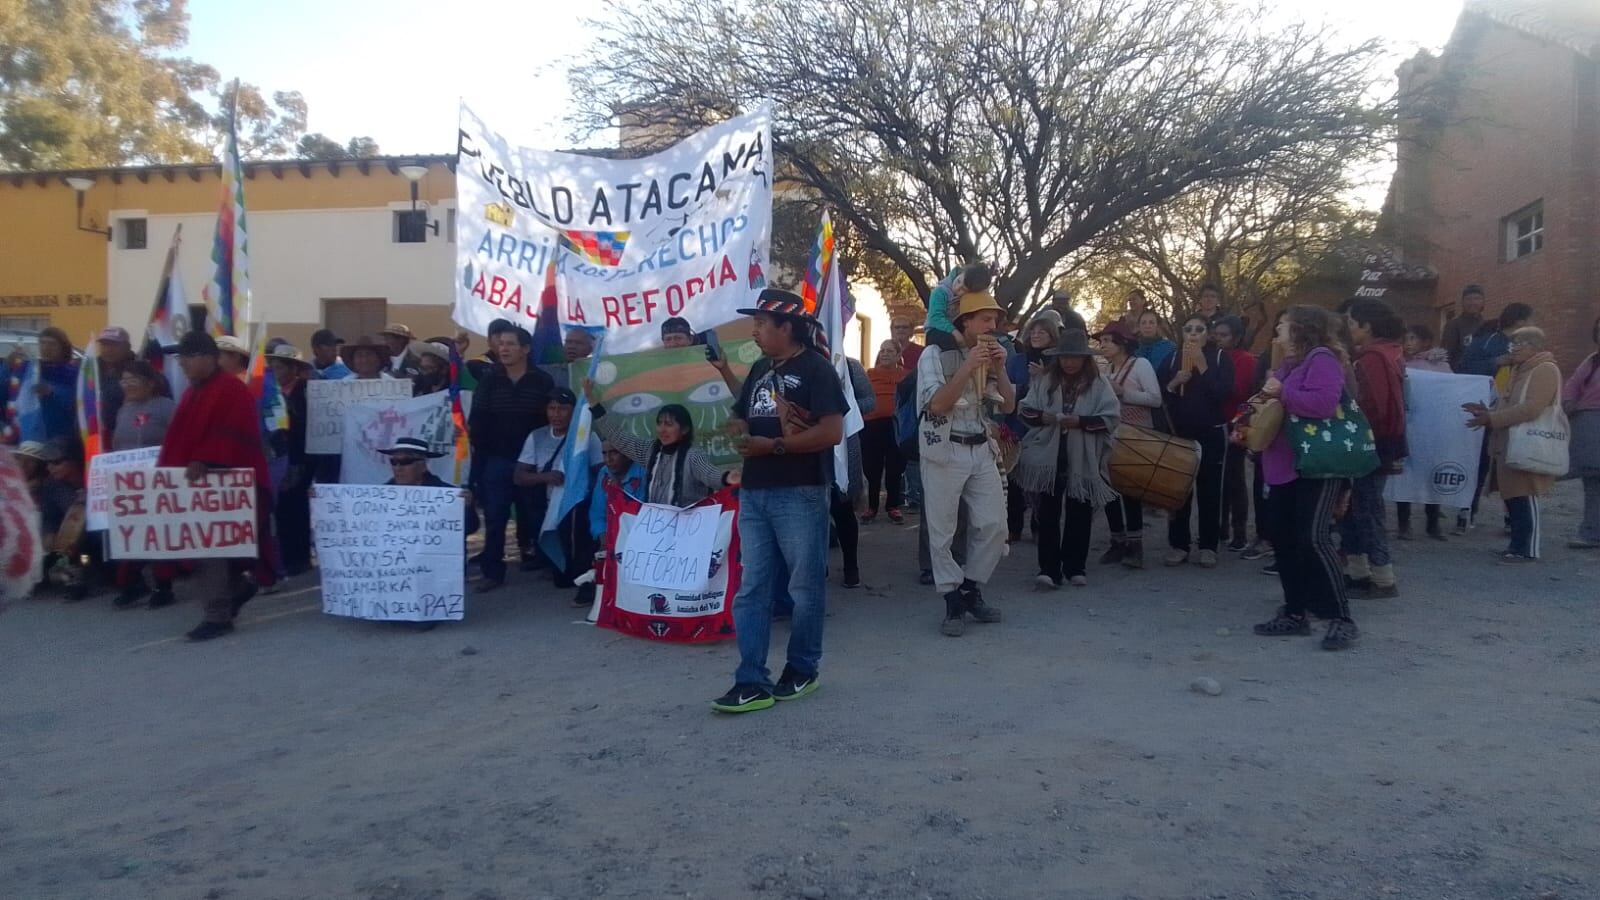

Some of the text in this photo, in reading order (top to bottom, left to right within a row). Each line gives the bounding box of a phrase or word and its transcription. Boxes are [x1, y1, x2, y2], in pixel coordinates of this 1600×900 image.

[477, 228, 567, 277] ARRIA
[1361, 269, 1383, 281] Paz
[471, 270, 541, 319] ABA
[567, 296, 587, 325] LA
[1354, 285, 1387, 297] Amor
[114, 470, 146, 492] NO
[152, 469, 179, 490] AL
[1433, 471, 1465, 486] UTEP
[113, 489, 253, 517] SI AL AGUA
[404, 488, 456, 504] KOLLAS
[326, 502, 343, 514] DE
[424, 519, 463, 532] NORTE
[635, 507, 702, 537] ABAJO
[118, 519, 256, 552] Y A LA VIDA
[383, 534, 442, 546] PESCADO
[653, 537, 677, 553] LA
[624, 549, 698, 585] REFORMA
[393, 602, 406, 614] DE
[420, 593, 465, 618] PAZ
